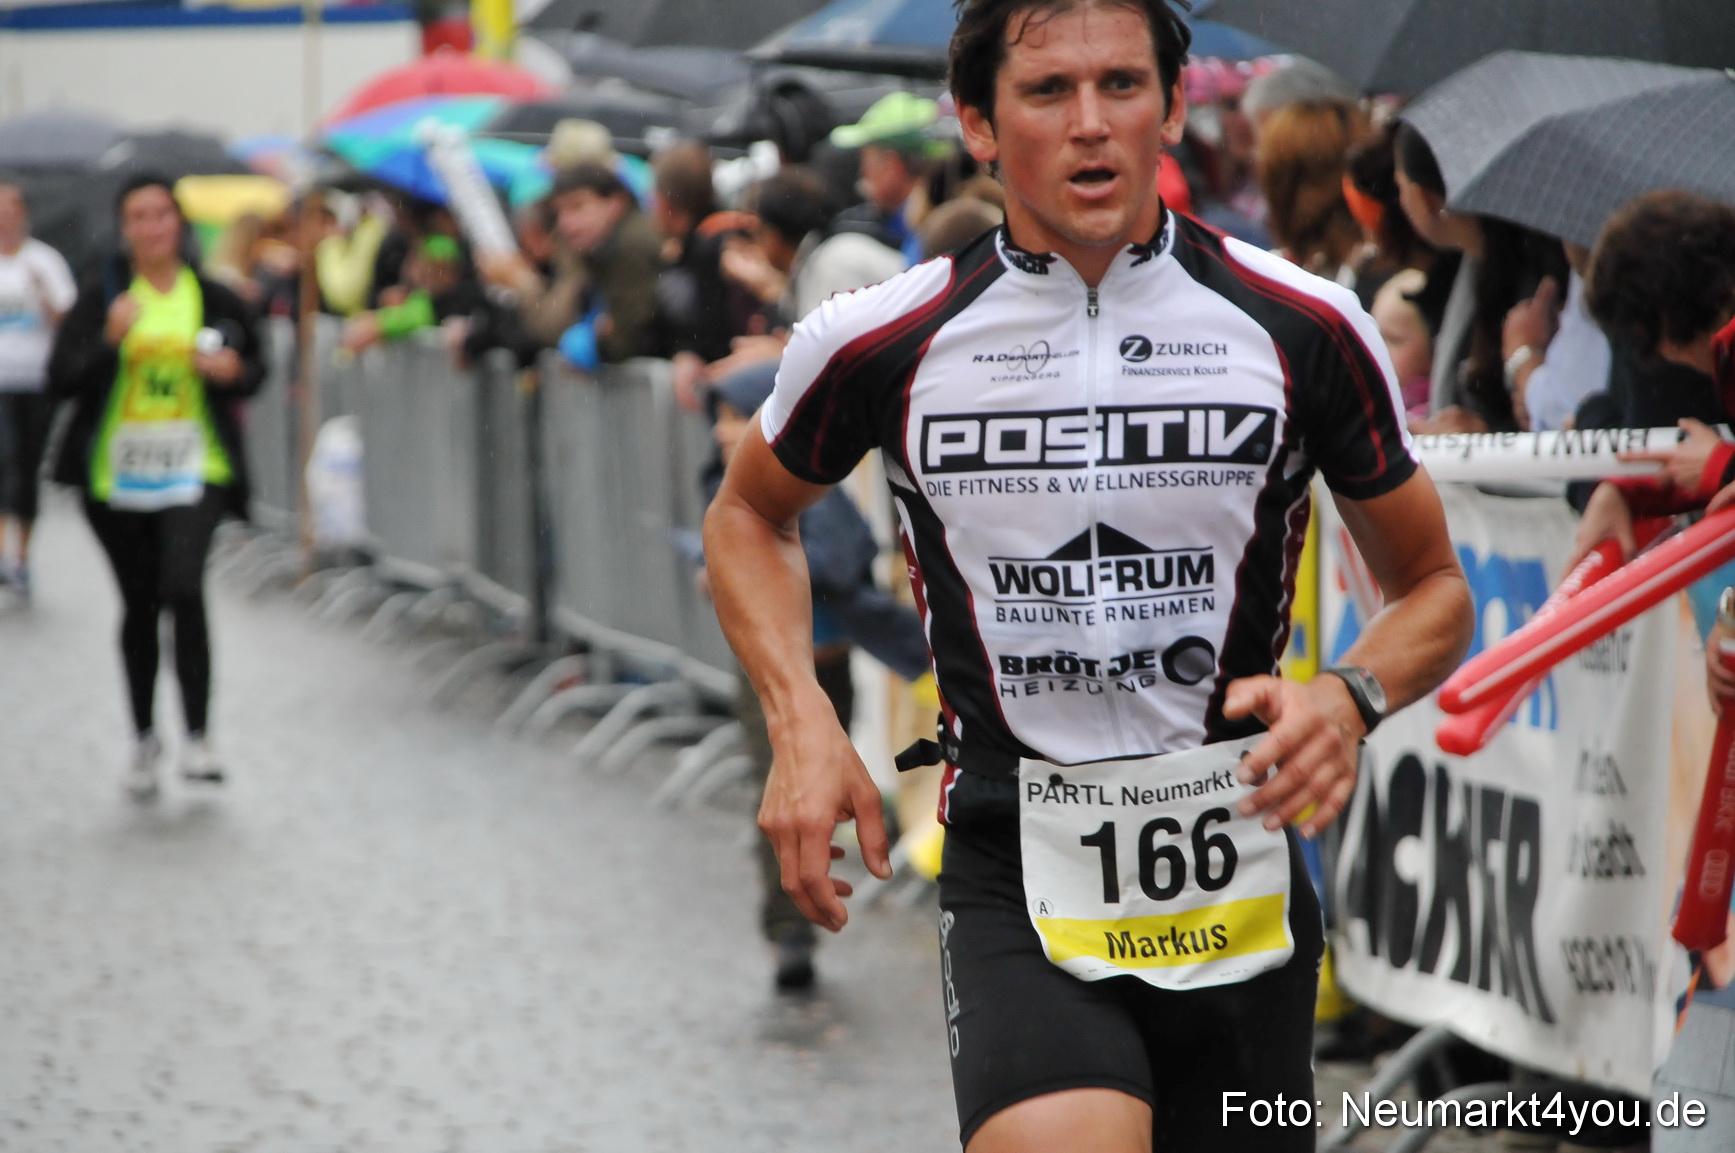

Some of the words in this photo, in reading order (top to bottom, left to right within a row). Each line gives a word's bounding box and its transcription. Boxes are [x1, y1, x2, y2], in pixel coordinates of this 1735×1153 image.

[1155, 343, 1228, 356] ZURICH
[1121, 365, 1192, 376] FINANZSERVICE
[1194, 365, 1228, 375] KOLLER
[927, 409, 1268, 468] POSITIV
[926, 479, 952, 497] DIE
[959, 475, 1039, 496] FITNESS
[1047, 475, 1061, 492] &
[1069, 470, 1256, 493] WELLNESSGRUPPE
[988, 552, 1215, 598] WOLFRUM
[996, 596, 1216, 626] BAUUNTERNEHMEN
[998, 650, 1156, 678] BRÖTJE
[1000, 674, 1157, 698] HEIZUNG
[1121, 770, 1235, 807] Neumarkt
[1080, 807, 1239, 904] 166
[1039, 900, 1049, 915] A
[1104, 923, 1229, 959] Markus
